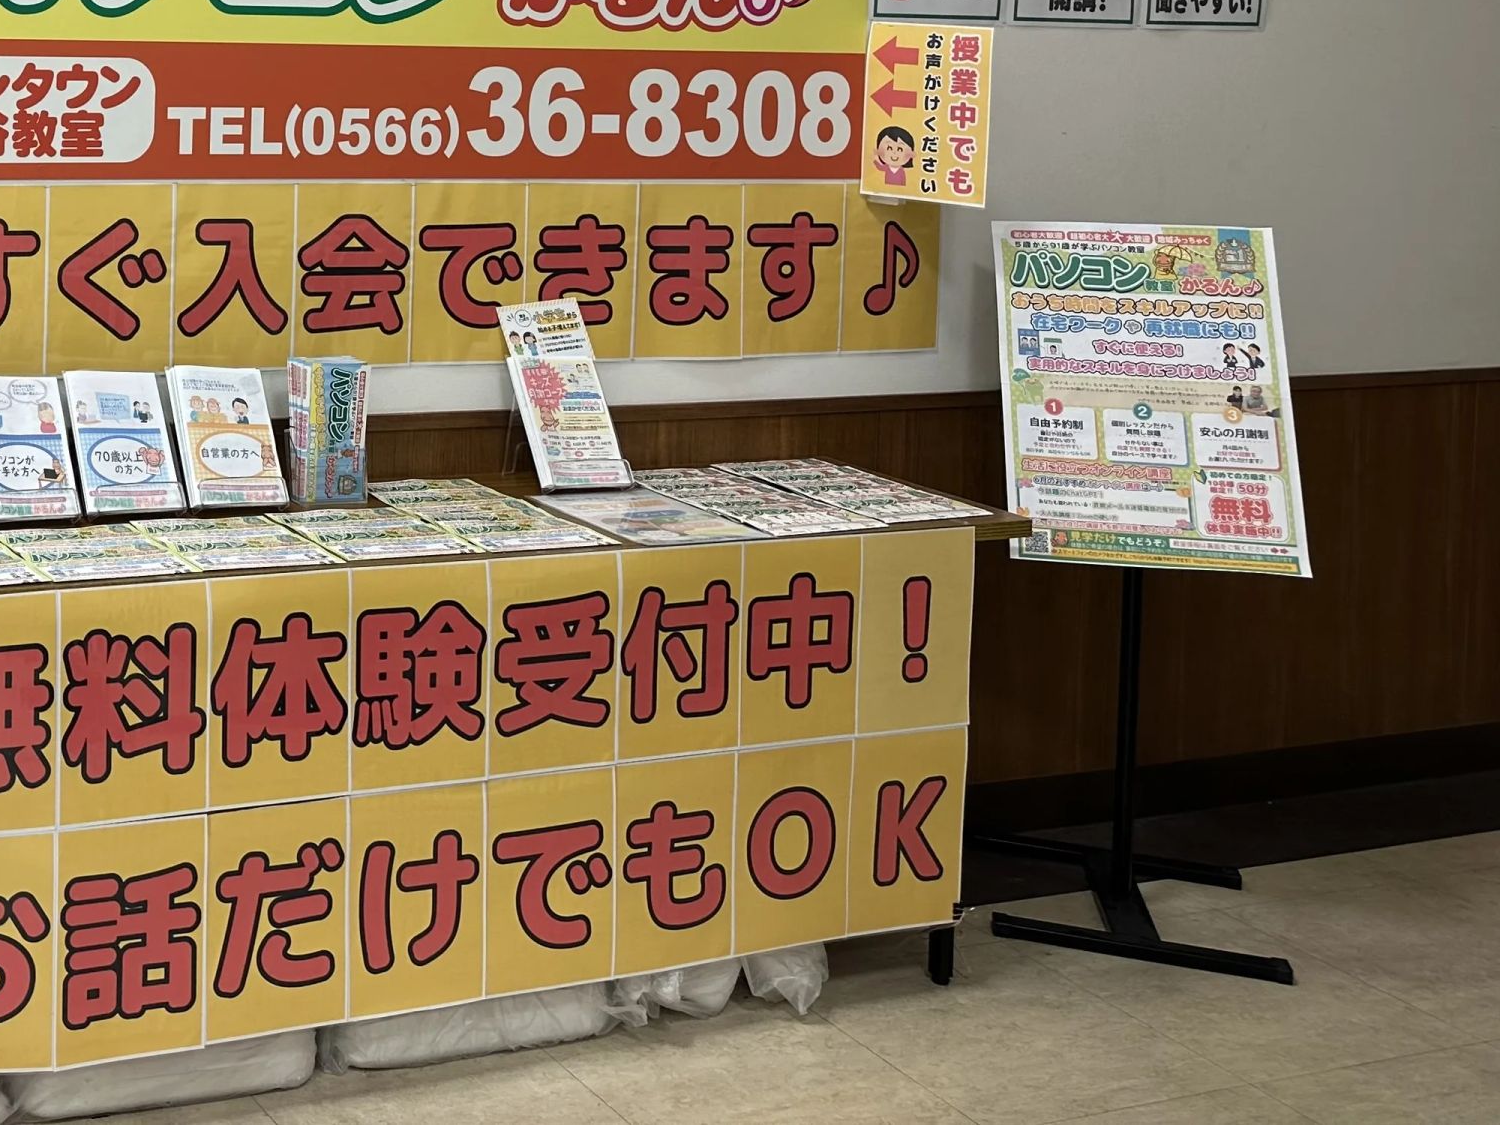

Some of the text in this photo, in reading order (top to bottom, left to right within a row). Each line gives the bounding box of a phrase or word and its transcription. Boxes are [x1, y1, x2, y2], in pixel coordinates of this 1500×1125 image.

[920, 33, 944, 193] お声がけください
[948, 35, 980, 195] 授業中でも
[1010, 250, 1152, 293] パソコン
[1092, 339, 1183, 357] すぐに使える!
[1029, 418, 1084, 430] 自由予約制
[1199, 427, 1269, 440] 安心の月謝制
[95, 451, 144, 462] 70歳以上
[201, 447, 260, 459] 自営業の方へ
[115, 465, 143, 474] の方へ
[1237, 482, 1269, 496] 50分
[1208, 495, 1274, 525] 無料
